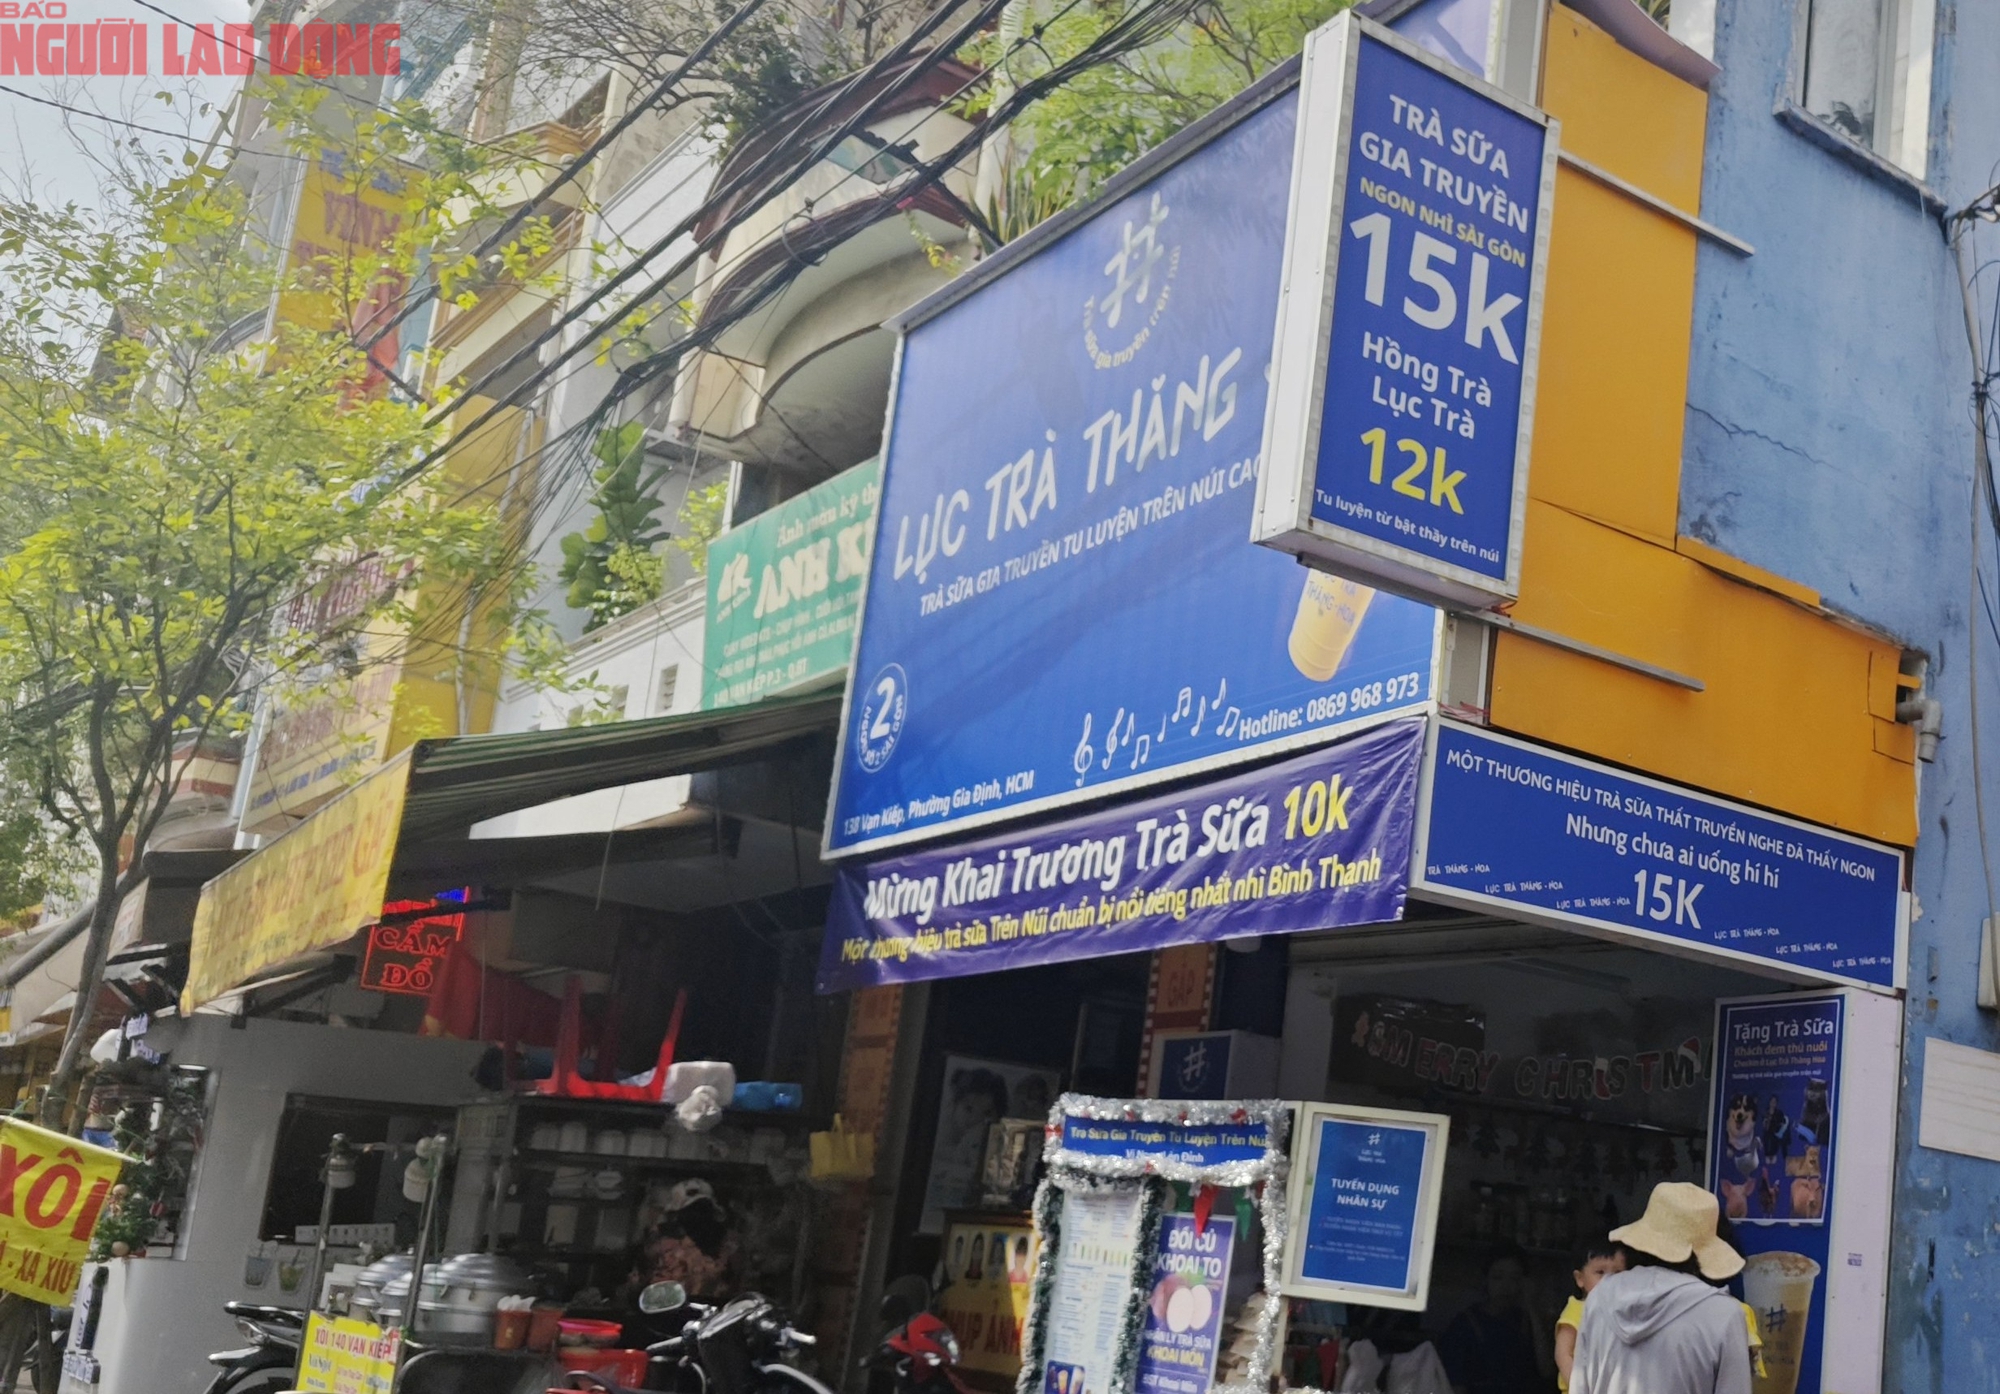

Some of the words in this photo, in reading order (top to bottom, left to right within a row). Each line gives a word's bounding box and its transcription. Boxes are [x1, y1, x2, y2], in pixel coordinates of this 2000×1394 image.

[1390, 94, 1444, 146] TRÀ
[1451, 128, 1509, 179] SỮA
[1360, 132, 1412, 178] GIA
[1420, 158, 1528, 233] TRUYỀN
[1360, 177, 1415, 217] NGON
[1419, 205, 1453, 235] NHÌ
[1456, 223, 1485, 249] SÀI
[1487, 238, 1526, 268] GÒN
[1362, 331, 1439, 392] Hồng
[1447, 366, 1492, 407] Trà
[1372, 375, 1422, 418] Lục
[1430, 398, 1475, 439] Trà
[894, 489, 969, 584] LỤC
[985, 428, 1057, 542] TRÀ
[1360, 427, 1467, 515] 12k
[919, 584, 944, 617] TRÀ
[946, 575, 974, 607] SỮA
[977, 564, 1001, 595] GIA
[1004, 539, 1061, 583] TRUYỀN
[1063, 529, 1084, 560] TU
[1086, 505, 1138, 551] LUYỆN
[1142, 485, 1186, 526] TRÊN
[1189, 466, 1226, 507] NÚI
[1316, 489, 1332, 506] Tu
[1336, 494, 1373, 519] luyện
[1376, 510, 1393, 526] từ
[1394, 515, 1416, 535] bật
[1450, 536, 1477, 555] trên
[1480, 548, 1499, 563] núi
[869, 677, 895, 740] 2
[1238, 706, 1303, 741] Hotline:
[1306, 691, 1347, 723] 0869
[1350, 681, 1382, 711] 968
[1386, 672, 1419, 703] 973
[861, 813, 880, 835] Vạn
[909, 796, 950, 820] Phường
[952, 788, 971, 808] Gia
[972, 779, 1003, 806] Định,
[1005, 769, 1035, 796] HCM
[1446, 749, 1484, 773] MỘT
[1486, 758, 1552, 792] THƯƠNG
[1555, 778, 1591, 802] HIỆU
[1594, 788, 1622, 811] TRÀ
[1623, 796, 1653, 820] SỮA
[1656, 806, 1692, 829] THẤT
[1748, 832, 1784, 856] NGHE
[1786, 841, 1804, 862] ĐÃ
[1806, 848, 1838, 873] THẤY
[1840, 857, 1875, 882] NGON
[864, 872, 938, 925] Mừng
[942, 850, 1006, 907] Khai
[1011, 835, 1126, 893] Trương
[1136, 809, 1190, 871] Trà
[1197, 795, 1269, 857] Sữa
[1283, 774, 1353, 840] 10k
[1566, 812, 1628, 856] Nhưng
[1631, 831, 1675, 862] chưa
[1677, 845, 1694, 867] ai
[1697, 849, 1741, 885] uống
[1744, 859, 1761, 883] hí
[1763, 864, 1780, 888] hí
[842, 937, 871, 965] Một
[944, 921, 962, 949] trà
[963, 919, 987, 946] sữa
[990, 914, 1018, 940] Trên
[1022, 906, 1048, 936] Núi
[1050, 896, 1095, 932] chuẩn
[1099, 895, 1113, 929] bị
[1115, 886, 1144, 922] nổi
[1190, 870, 1232, 910] nhất
[1233, 867, 1266, 901] nhì
[1268, 859, 1313, 896] Bình
[1319, 847, 1382, 893] Thạnh
[1634, 869, 1705, 930] 15K
[1733, 1022, 1770, 1044] Tặng
[1774, 1019, 1799, 1038] Trà
[1803, 1017, 1834, 1036] Sữa
[1734, 1045, 1762, 1057] Khách
[1764, 1044, 1785, 1055] đem
[1514, 1040, 1713, 1100] CHRISTM
[1157, 1252, 1201, 1275] KHOAI
[1202, 1256, 1222, 1279] TO
